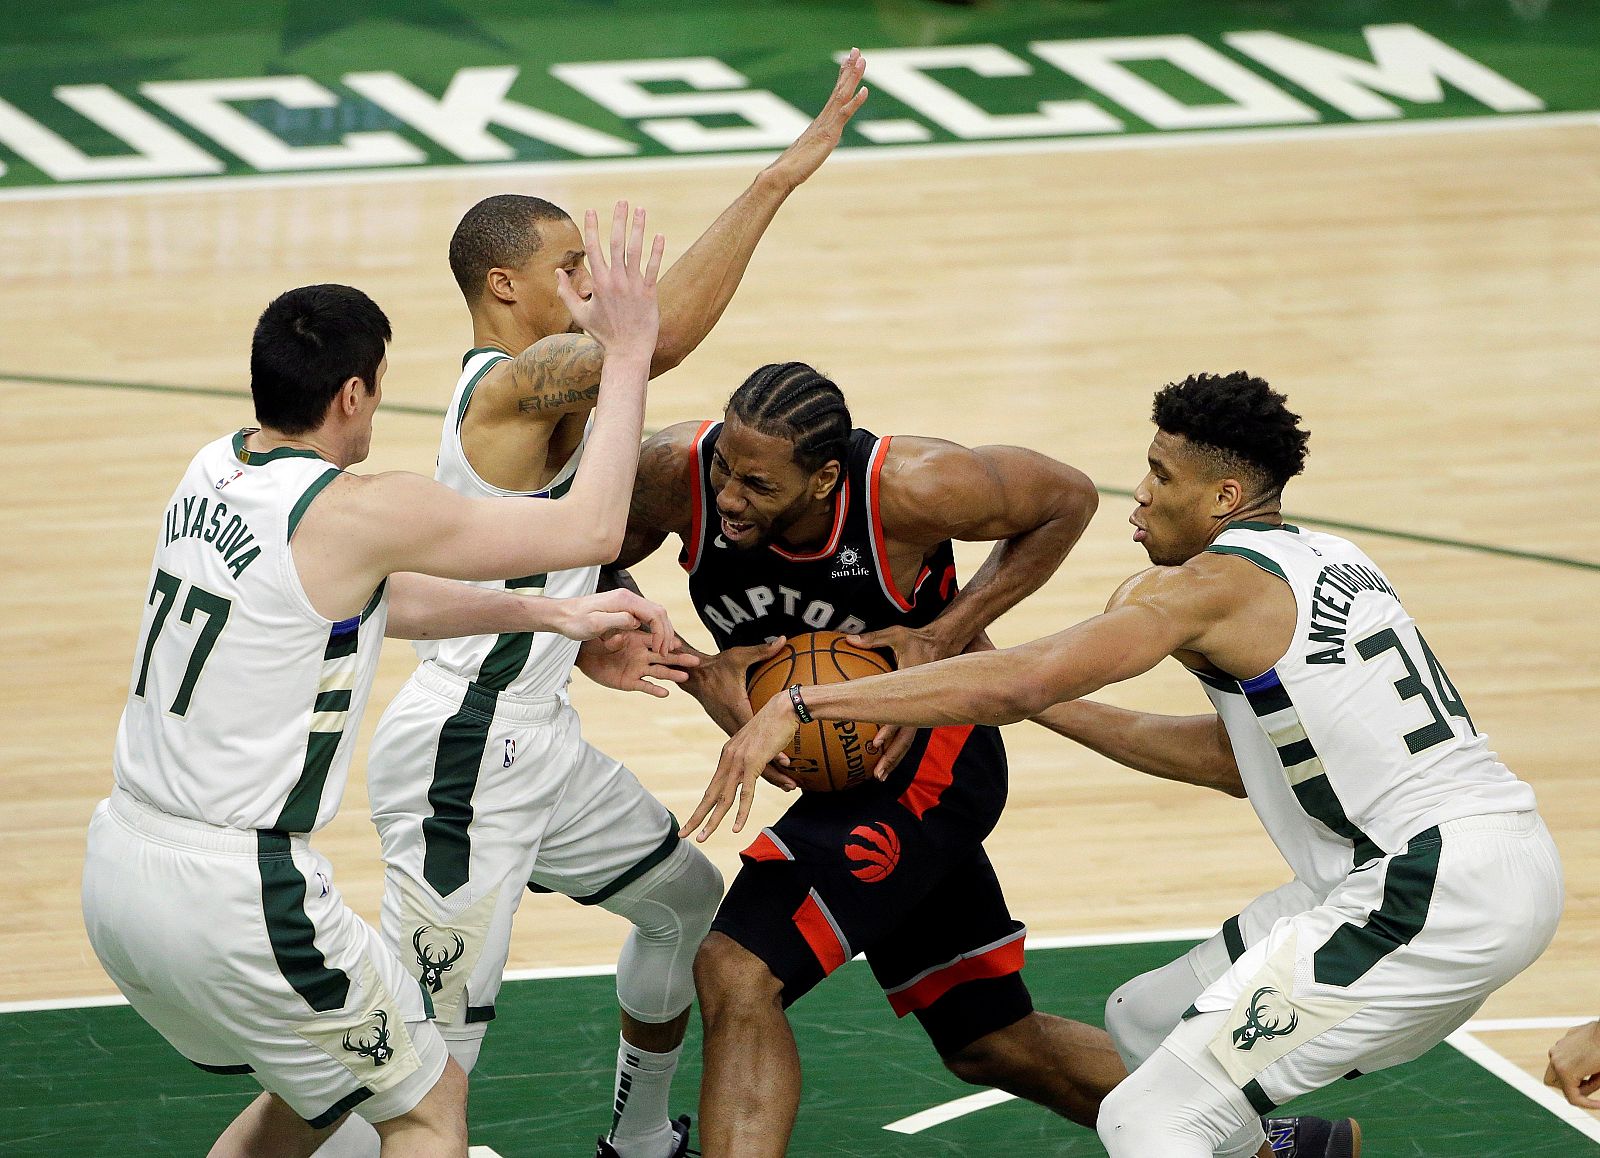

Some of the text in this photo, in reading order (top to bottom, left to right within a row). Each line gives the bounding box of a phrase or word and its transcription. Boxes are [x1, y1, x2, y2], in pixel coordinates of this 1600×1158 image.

[0, 23, 1547, 182] UCKS.COM
[165, 495, 262, 581] ILYASOVA
[831, 567, 870, 579] Sun Life
[134, 567, 233, 718] 77
[704, 585, 867, 635] RAPTOR
[1354, 625, 1478, 755] 34
